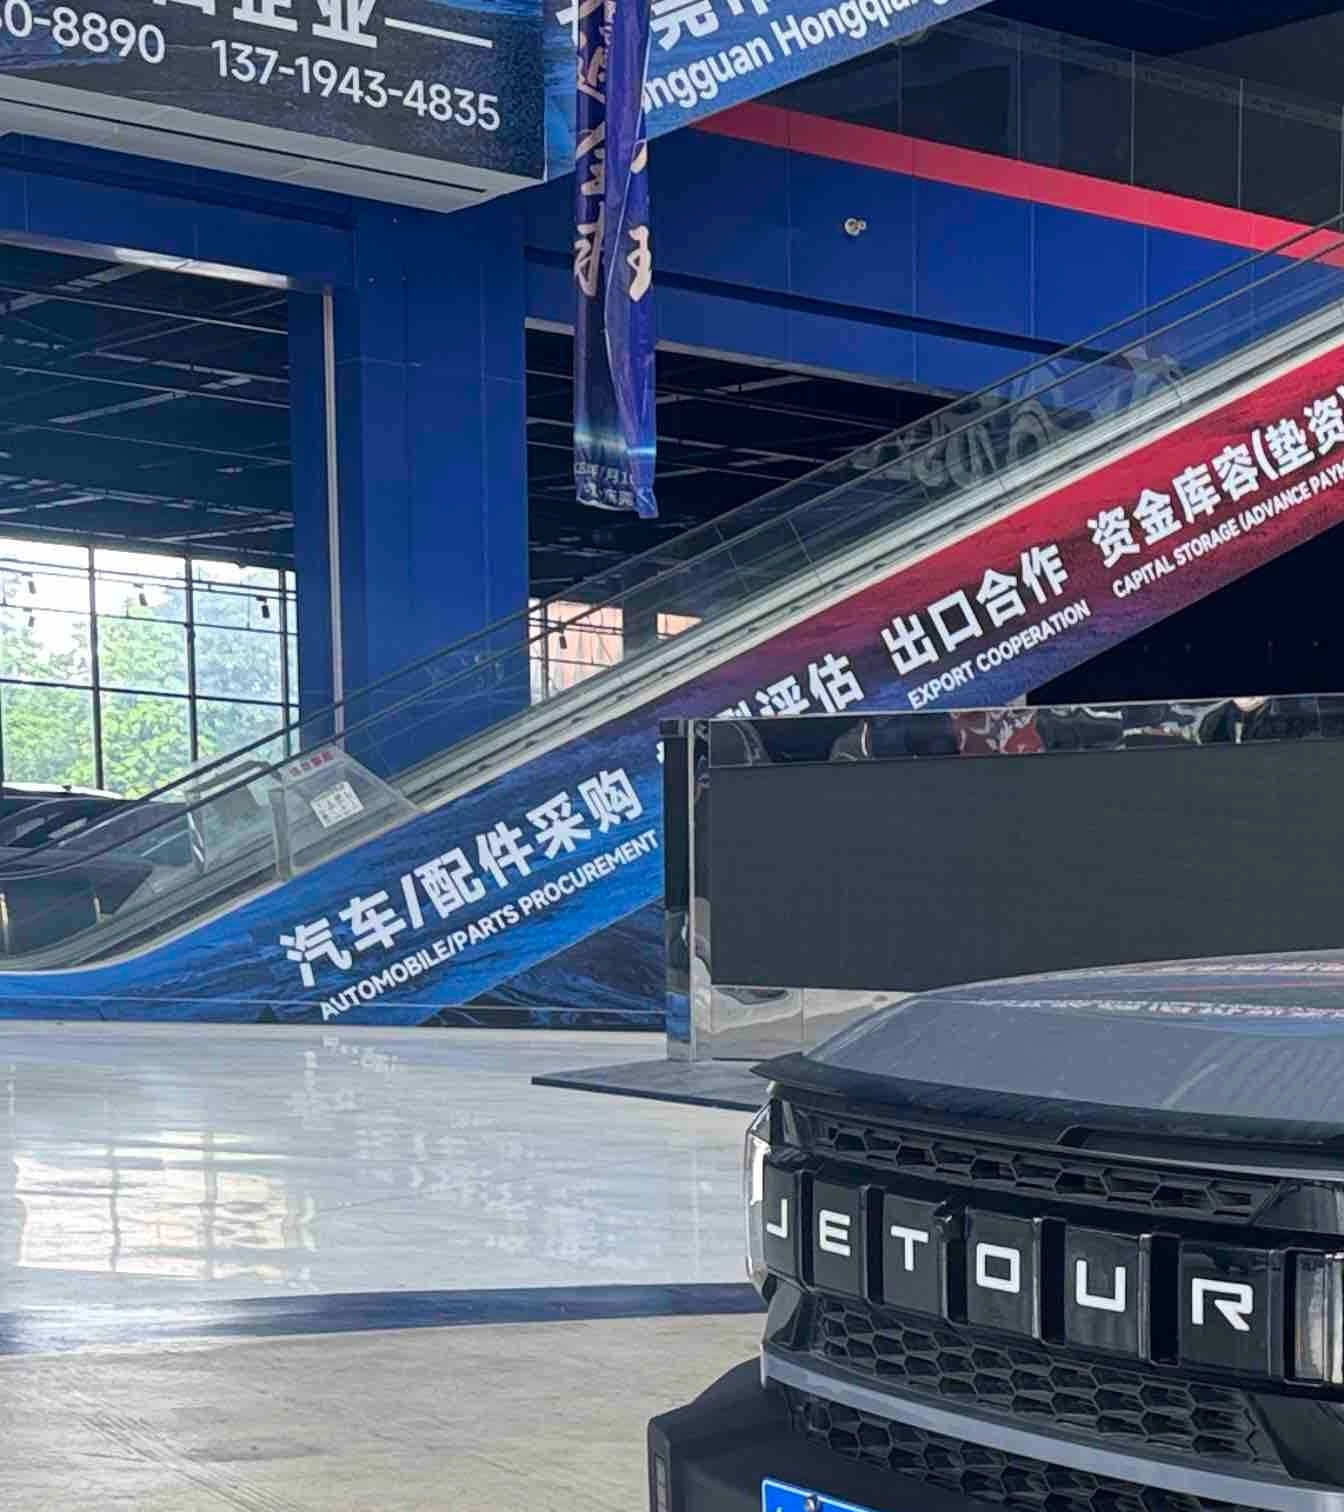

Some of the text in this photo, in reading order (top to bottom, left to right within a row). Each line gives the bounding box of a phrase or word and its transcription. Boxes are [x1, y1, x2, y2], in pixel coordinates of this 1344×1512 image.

[0, 0, 165, 63] 0-8890
[211, 40, 501, 131] 137-1943-4835
[638, 37, 774, 114] ngguan
[1112, 555, 1176, 598] CAPITAL
[1174, 519, 1240, 567] STORAGE
[1239, 481, 1312, 531] (ADVANCE
[881, 544, 1068, 675] 出口合作
[906, 599, 1091, 710] EXPORT COOPERATION
[280, 767, 643, 987] 汽车/配件采购
[319, 830, 660, 1021] AUTOMOBILE/PARTS PROCUREMENT
[766, 1198, 1255, 1332] JETOUR
